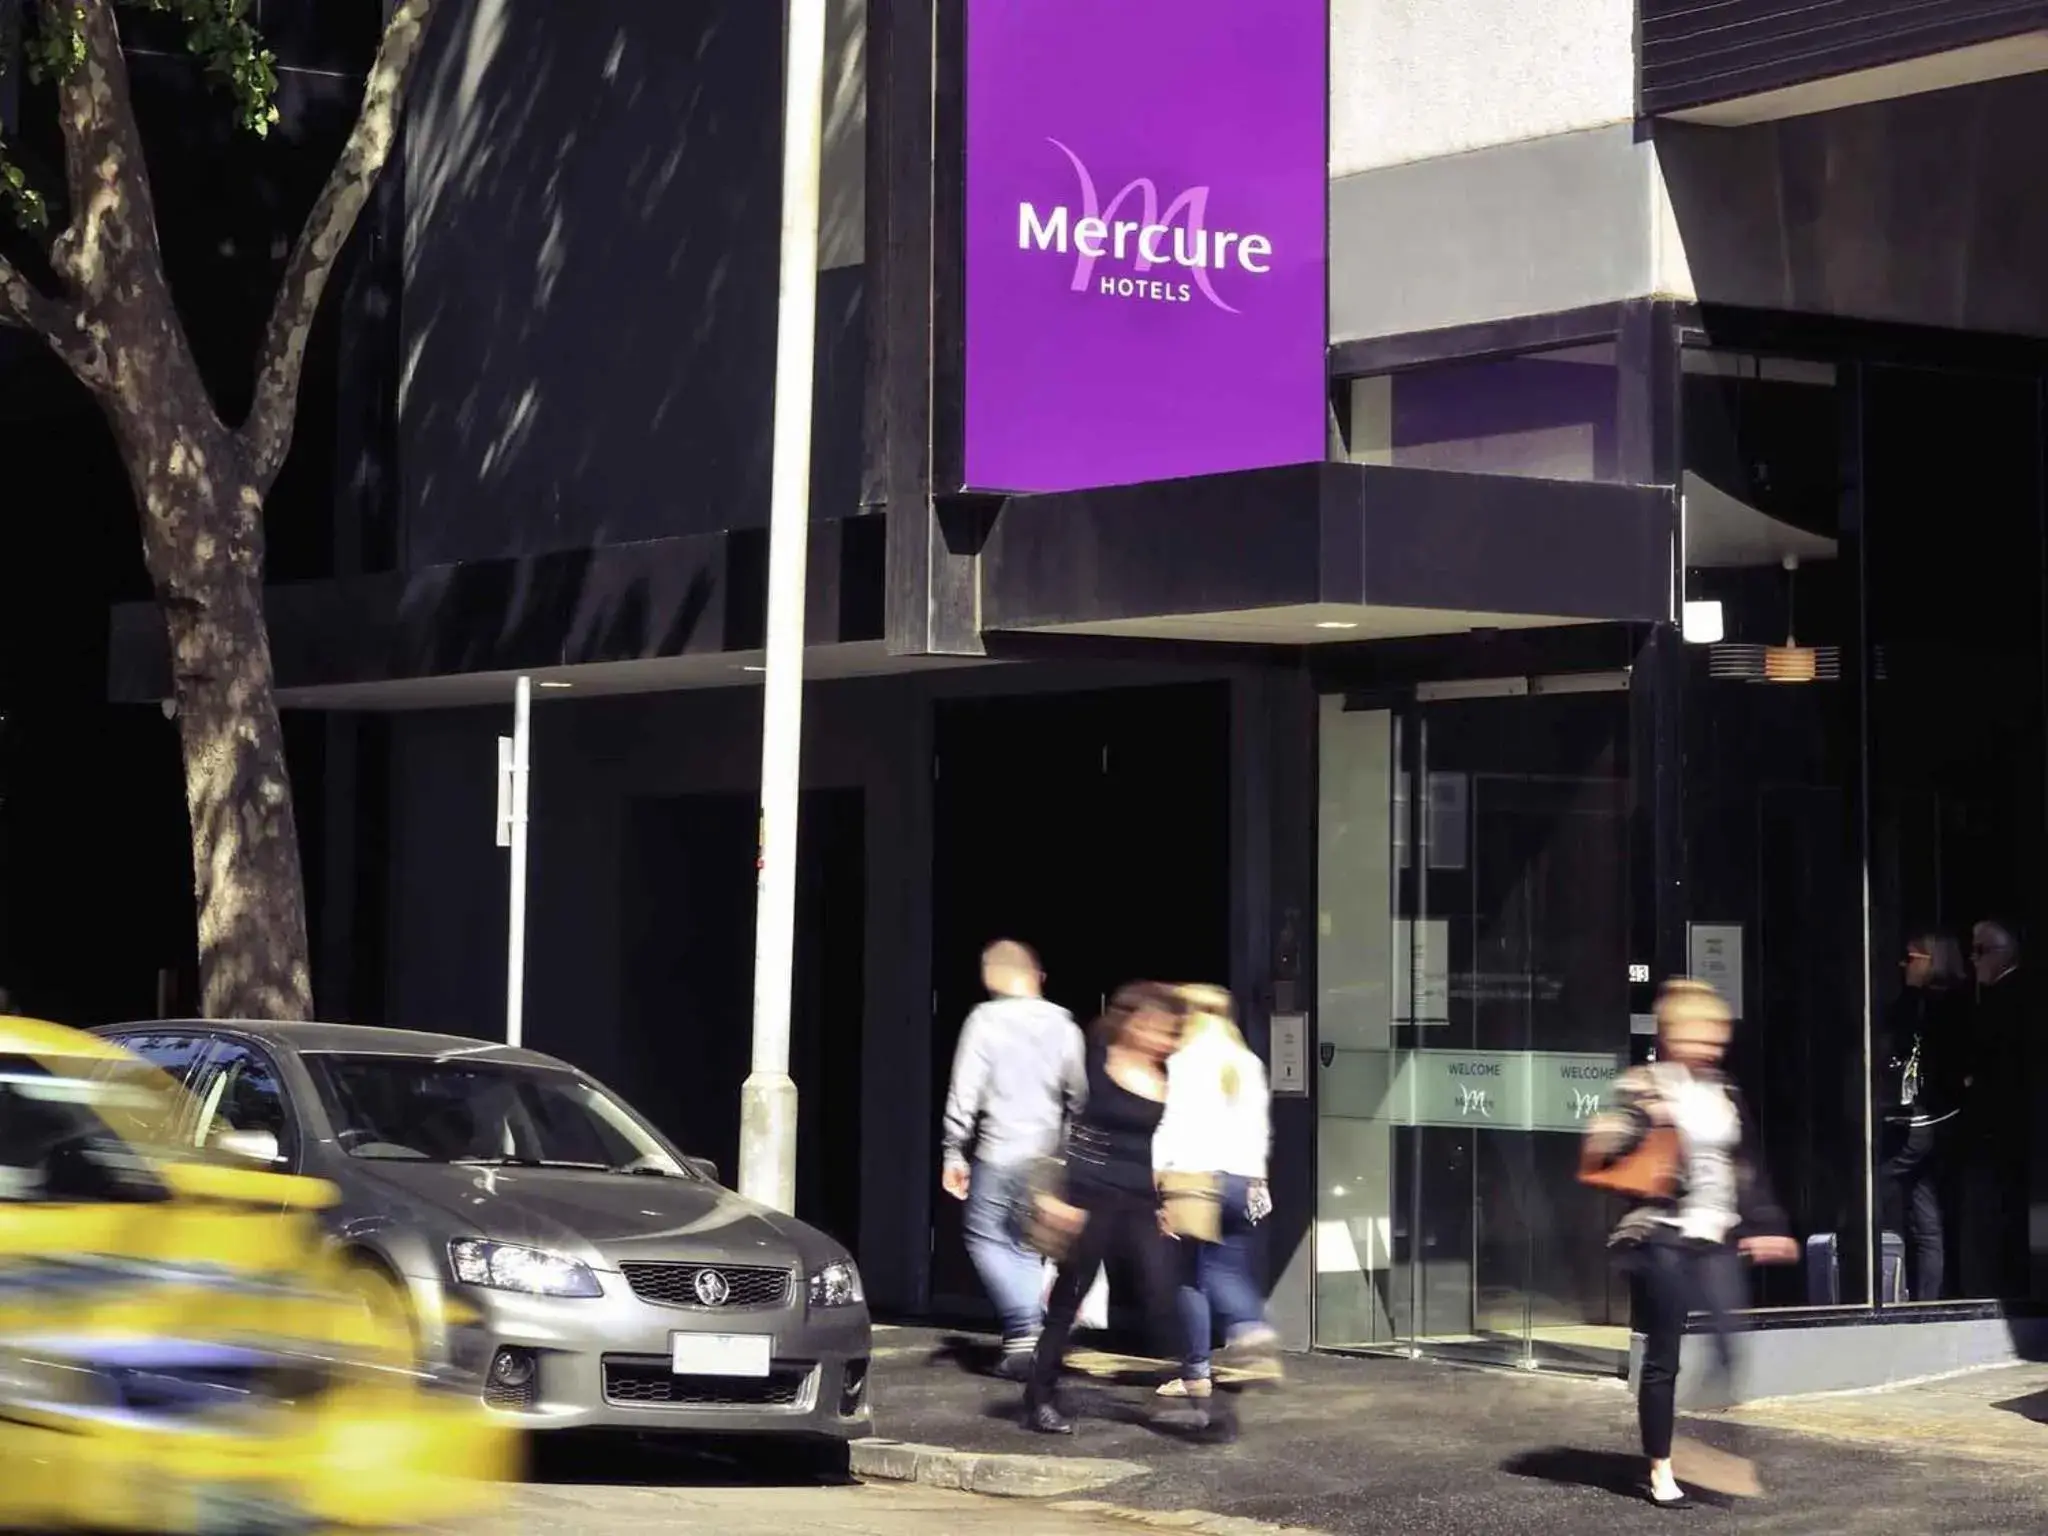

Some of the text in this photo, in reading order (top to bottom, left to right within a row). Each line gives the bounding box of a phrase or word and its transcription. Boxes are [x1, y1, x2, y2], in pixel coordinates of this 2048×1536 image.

[1018, 201, 1273, 274] Mercure
[1100, 276, 1192, 302] HOTELS
[1449, 1063, 1501, 1077] WELCOME
[1560, 1066, 1616, 1080] WELCOME
